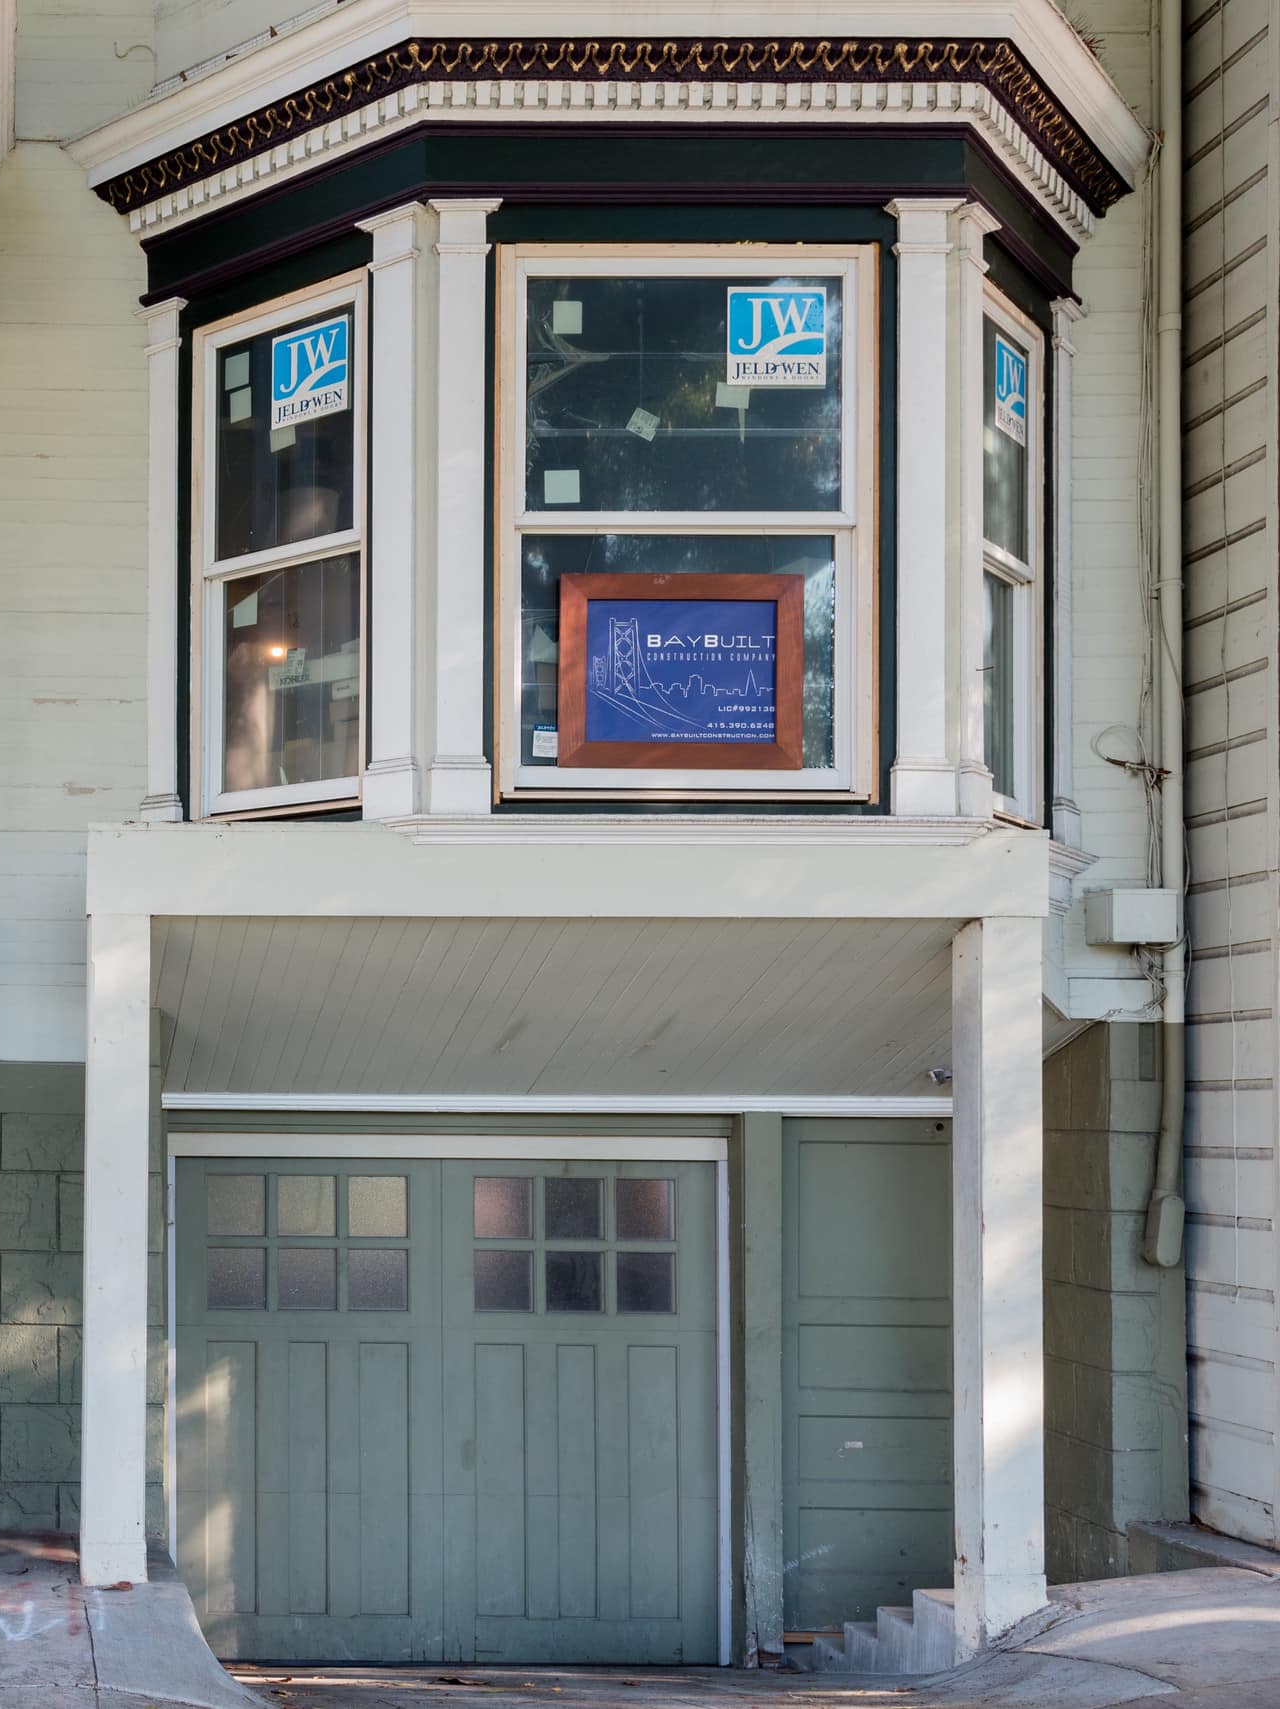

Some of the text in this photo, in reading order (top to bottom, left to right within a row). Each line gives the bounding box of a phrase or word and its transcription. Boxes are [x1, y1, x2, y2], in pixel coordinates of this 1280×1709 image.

[738, 298, 817, 349] JW
[279, 328, 340, 393] JW
[998, 350, 1023, 397] JW
[646, 652, 776, 661] CONSTRUCTION COMPANY
